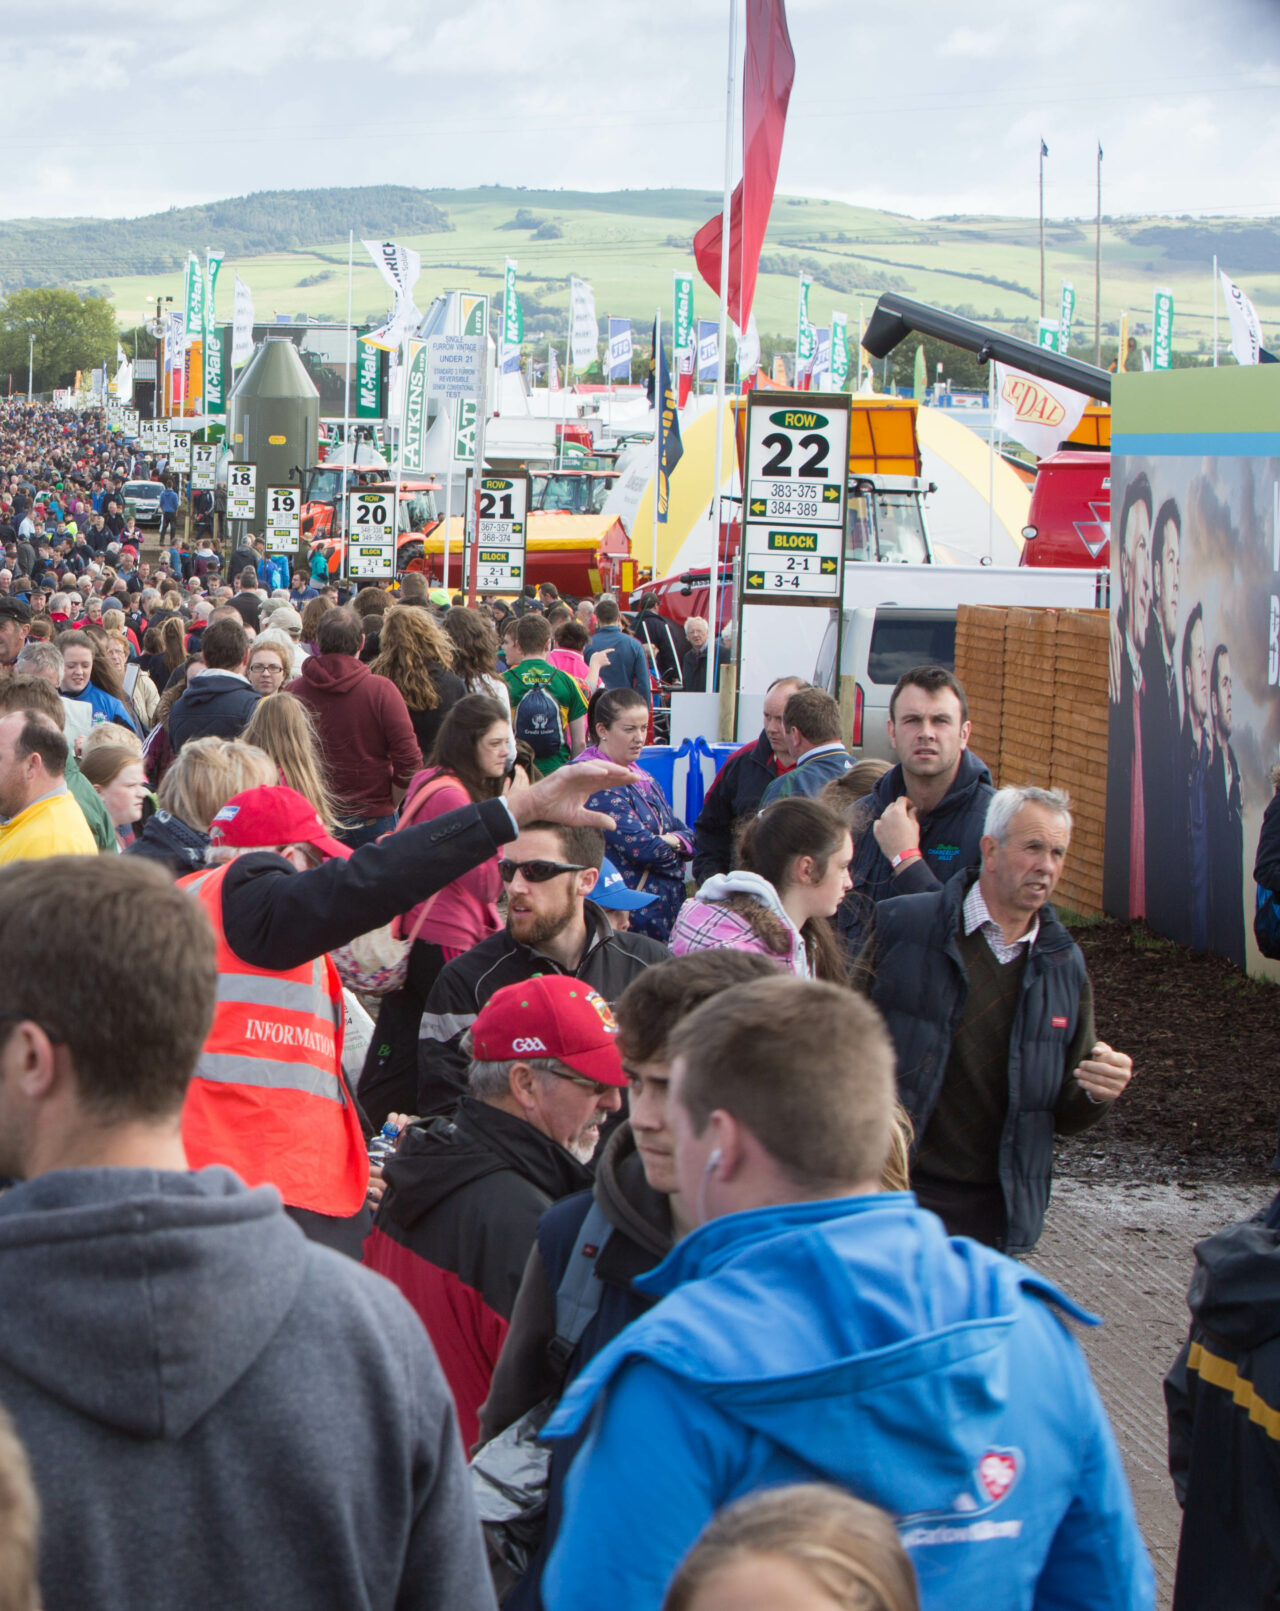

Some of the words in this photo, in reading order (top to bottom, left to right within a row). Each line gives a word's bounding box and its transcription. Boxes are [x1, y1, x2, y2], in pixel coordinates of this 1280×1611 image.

[189, 264, 202, 331] McHale
[678, 280, 691, 347] McHale
[1156, 296, 1171, 368] McHale
[440, 355, 462, 363] UNDER
[466, 355, 473, 363] 21
[207, 338, 221, 404] McHale
[360, 343, 377, 409] McHale
[785, 413, 816, 427] ROW
[174, 439, 188, 448] 16
[196, 451, 212, 461] 17
[761, 432, 830, 478] 22
[232, 473, 251, 485] 18
[486, 480, 506, 489] ROW
[771, 484, 817, 499] 383-375
[272, 497, 295, 512] 19
[479, 492, 515, 519] 21
[770, 501, 818, 517] 384-389
[356, 504, 387, 525] 20
[774, 534, 815, 548] BLOCK
[482, 552, 507, 560] BLOCK
[489, 567, 504, 575] 2-1
[786, 557, 809, 571] 2-1
[483, 577, 499, 586] 3-4
[774, 575, 800, 588] 3-4
[245, 1018, 336, 1059] INFORMATION
